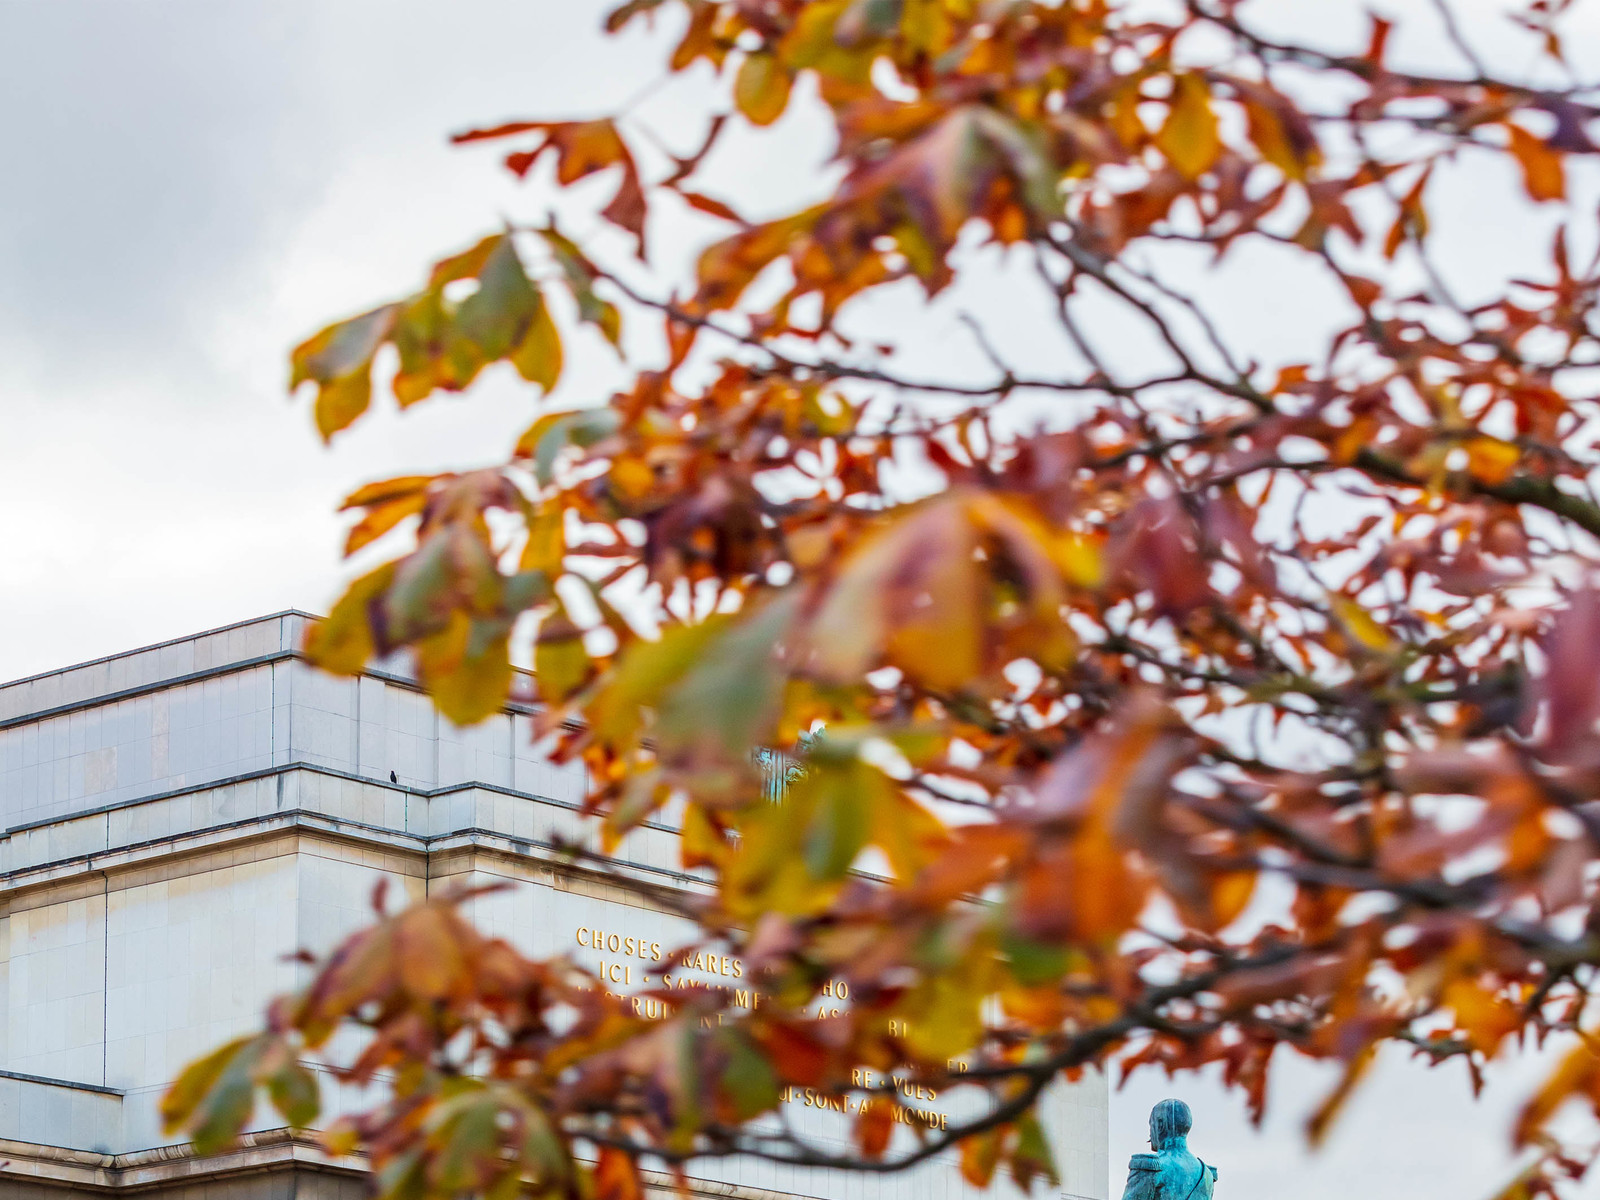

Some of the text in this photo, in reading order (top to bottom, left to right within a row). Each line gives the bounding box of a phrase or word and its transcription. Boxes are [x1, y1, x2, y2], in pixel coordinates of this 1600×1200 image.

[577, 927, 743, 978] CHOSES RARES
[600, 961, 631, 984] ICI
